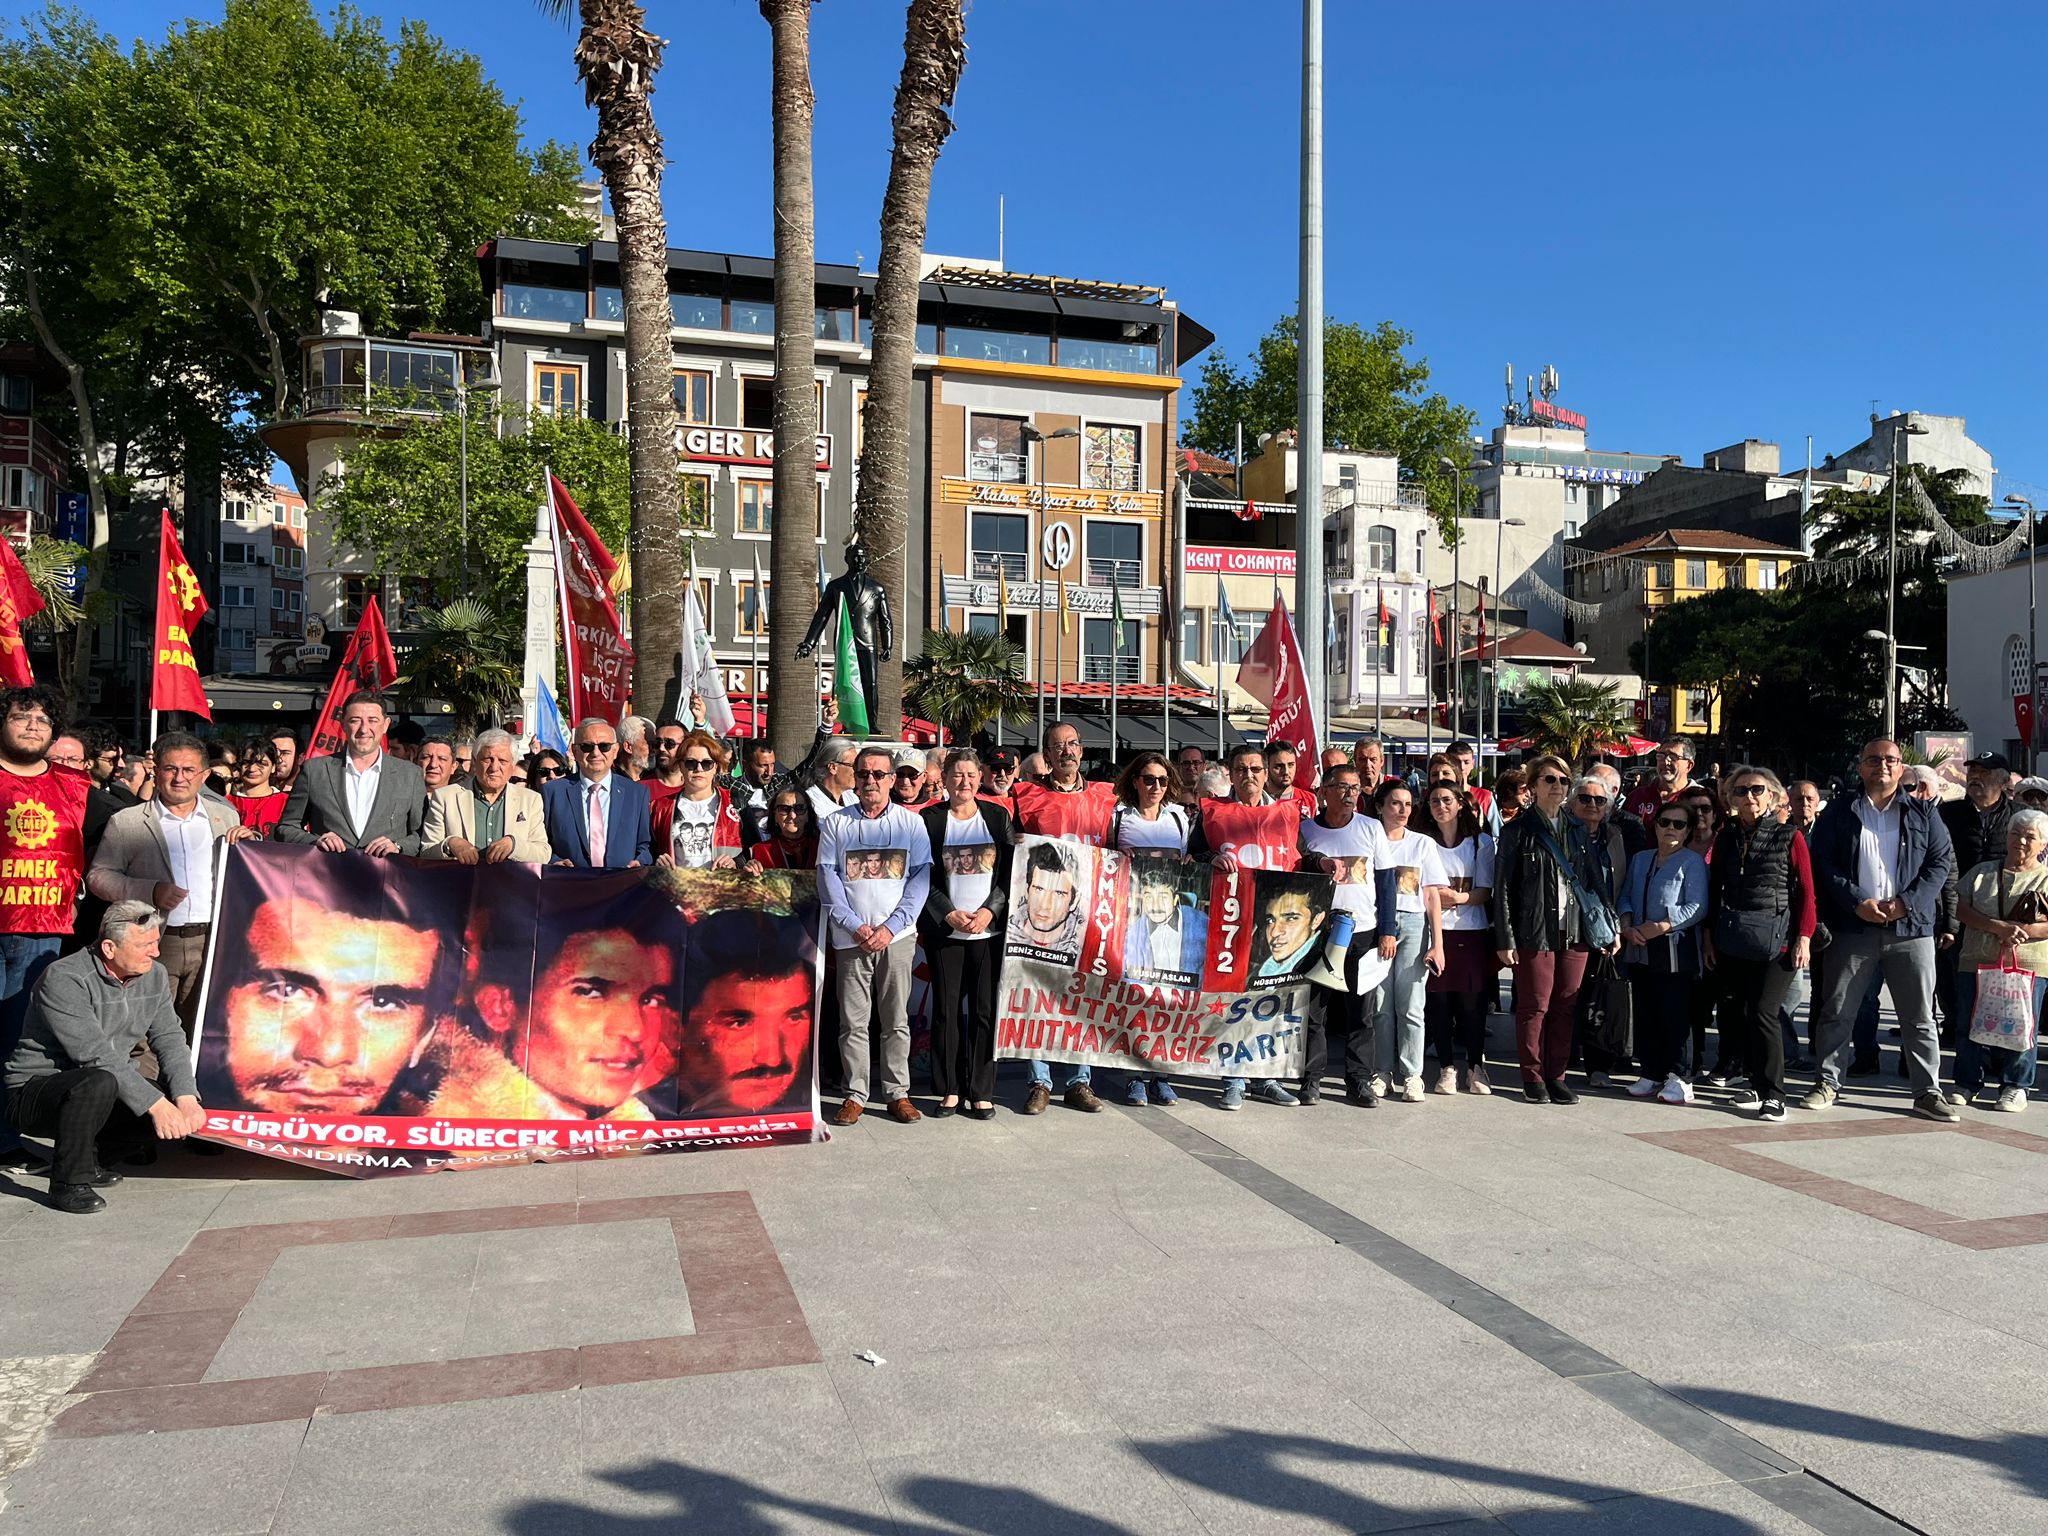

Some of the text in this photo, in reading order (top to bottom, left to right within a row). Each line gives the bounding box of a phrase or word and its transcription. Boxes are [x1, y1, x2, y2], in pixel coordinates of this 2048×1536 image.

[1533, 398, 1587, 430] HOTEL ODAMAN
[675, 428, 828, 463] RGER KG
[1621, 469, 1645, 485] PU
[1186, 551, 1222, 568] KENT
[18, 818, 48, 830] EMEP
[1, 858, 58, 879] EMEK
[1220, 842, 1284, 871] SOL
[0, 881, 63, 906] ARTİSİ
[1008, 946, 1068, 963] DENİZ GEZMİŞ
[1068, 972, 1087, 995] 3
[1133, 969, 1191, 983] YUSUF ASLAN
[1008, 988, 1205, 1034] UNUTMADIK
[1226, 993, 1303, 1025] SOL
[1217, 1026, 1303, 1067] PARTİ
[207, 1114, 396, 1146] SÜRÜYOR,
[407, 1121, 557, 1148] SÜRECEK
[247, 1138, 413, 1169] BANDIRMA
[608, 1133, 773, 1154] PLATFORMU
